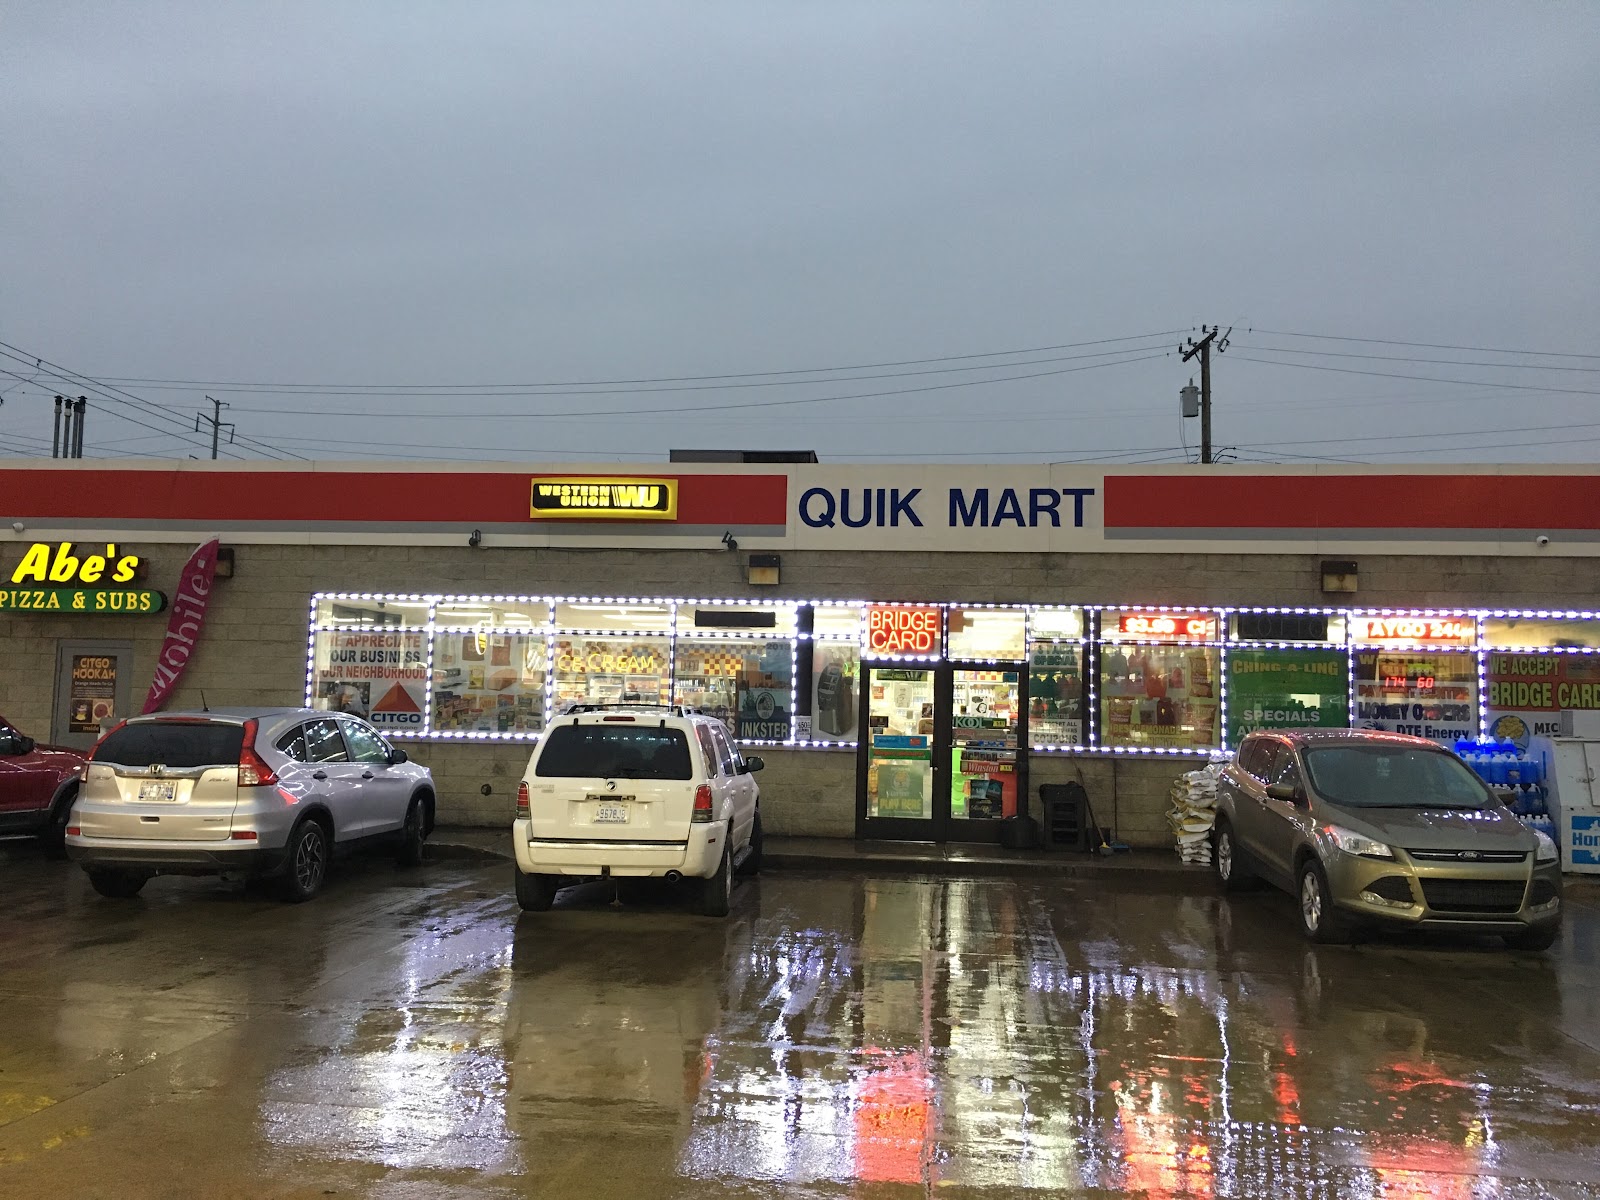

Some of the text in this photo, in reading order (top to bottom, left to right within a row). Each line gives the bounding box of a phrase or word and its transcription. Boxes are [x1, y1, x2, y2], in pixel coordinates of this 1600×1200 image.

[538, 485, 610, 496] WESTERN
[560, 496, 609, 507] UNION
[799, 487, 1095, 529] QUIK MART
[11, 542, 139, 583] Abe's
[0, 591, 151, 610] PIZZA & SUBS
[870, 611, 937, 630] BRIDGE
[346, 635, 420, 648] APPRECIATE
[871, 630, 931, 650] CARD
[80, 657, 110, 668] CITGO
[588, 653, 654, 671] CREAM
[1034, 655, 1077, 665] SPECIAL
[1489, 656, 1560, 676] WE ACCEPT
[73, 668, 116, 679] HOOKAH
[321, 666, 427, 679] OUR NEIGHBORHOOD
[1385, 677, 1434, 688] 174 60
[1488, 682, 1553, 707] BRIDGE
[371, 713, 422, 723] CITGO
[1243, 709, 1320, 723] SPECIALS
[1359, 702, 1470, 721] MONEY ORDERS
[955, 716, 986, 728] KOOL
[1534, 722, 1561, 735] MIC
[741, 722, 789, 738] INKSTER
[1397, 725, 1470, 742] DTE Energy
[1034, 734, 1078, 743] COUPONS
[968, 762, 999, 772] Winston
